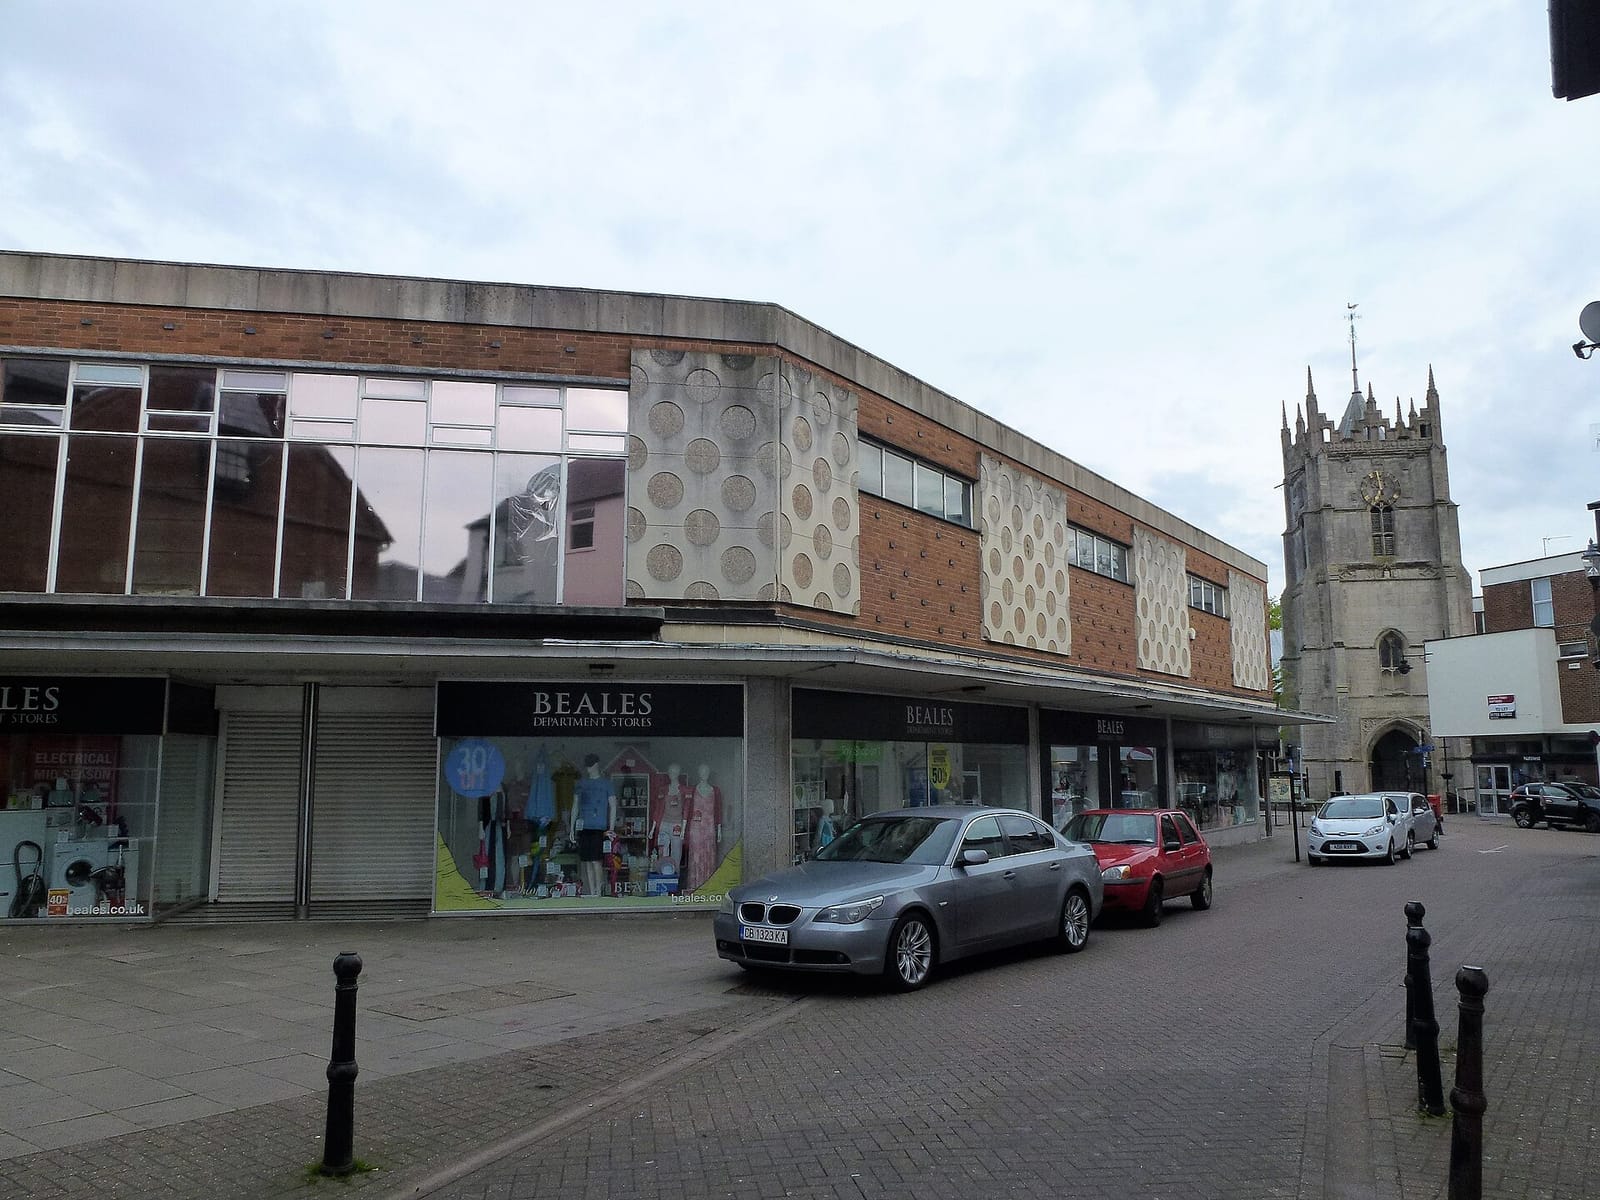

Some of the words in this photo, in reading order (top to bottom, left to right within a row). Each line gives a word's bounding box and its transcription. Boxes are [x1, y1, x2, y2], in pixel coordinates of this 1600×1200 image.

[532, 691, 653, 715] BEALES
[11, 713, 59, 724] STORES
[533, 716, 607, 728] DEPARTMENT
[610, 716, 652, 728] STORES
[905, 704, 954, 727] BEALES
[1097, 719, 1125, 735] BEALES
[34, 751, 112, 765] ELECTRICAL
[65, 903, 145, 916] beales.co.uk
[755, 929, 774, 941] 1323
[774, 930, 786, 943] KA
